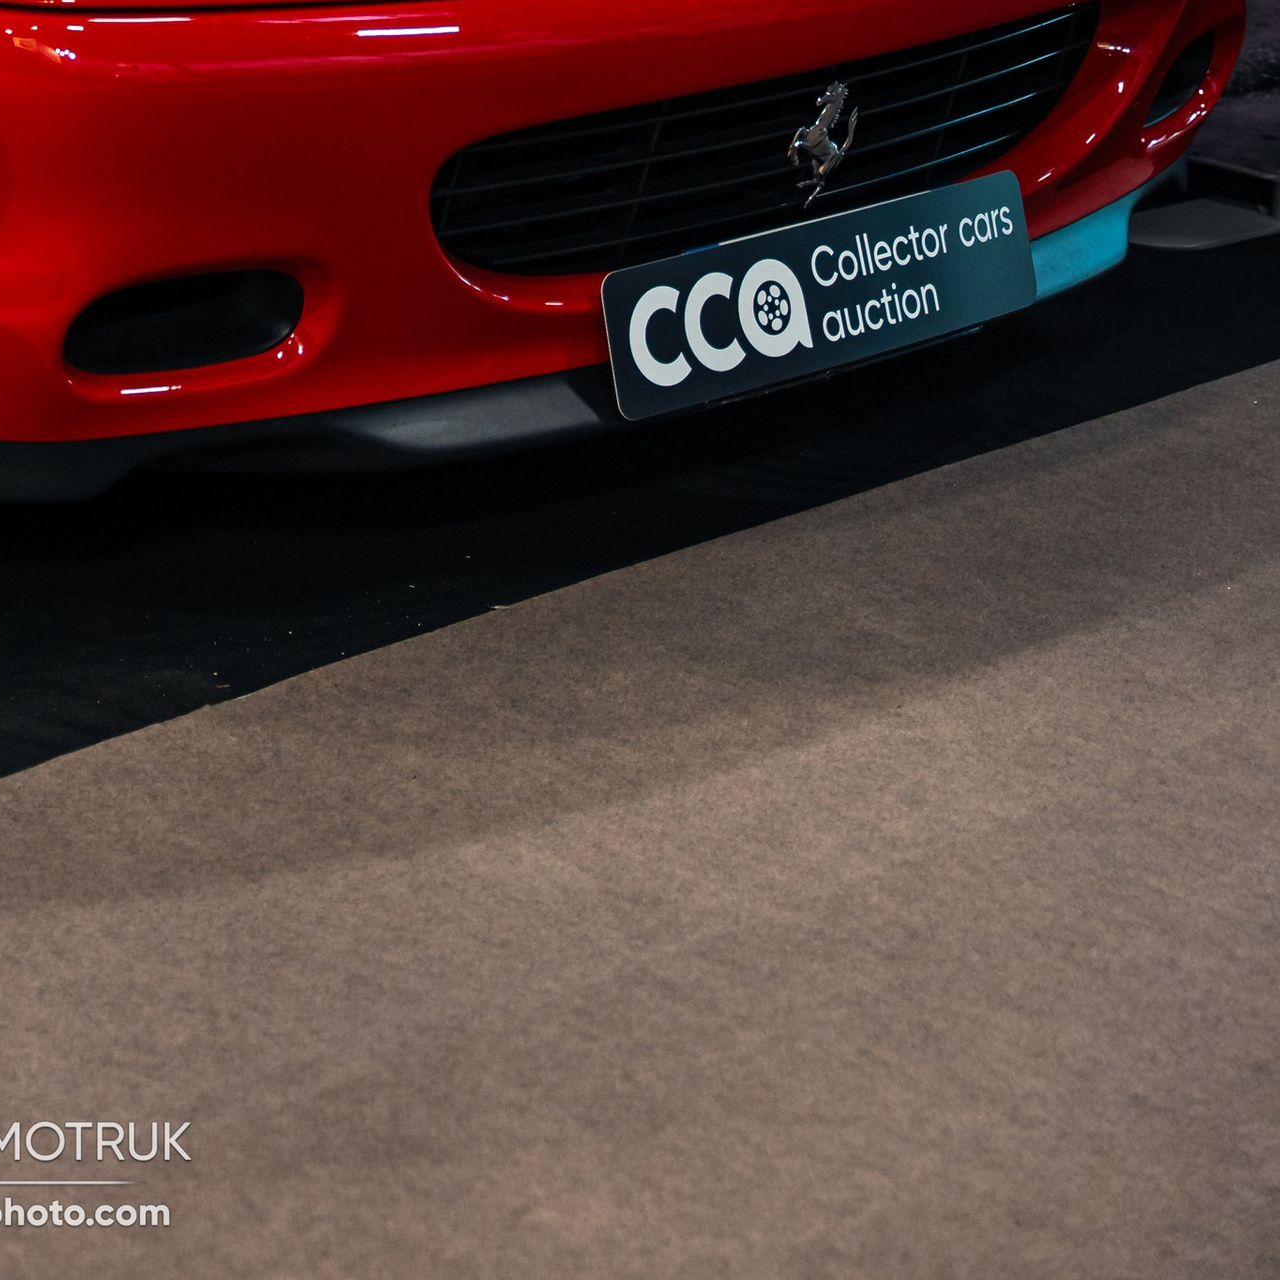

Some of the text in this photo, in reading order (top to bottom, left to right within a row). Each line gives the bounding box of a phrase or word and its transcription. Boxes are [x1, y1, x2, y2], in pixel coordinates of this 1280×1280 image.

[811, 204, 1014, 287] Collector cars
[629, 258, 814, 387] cca
[822, 281, 940, 342] auction
